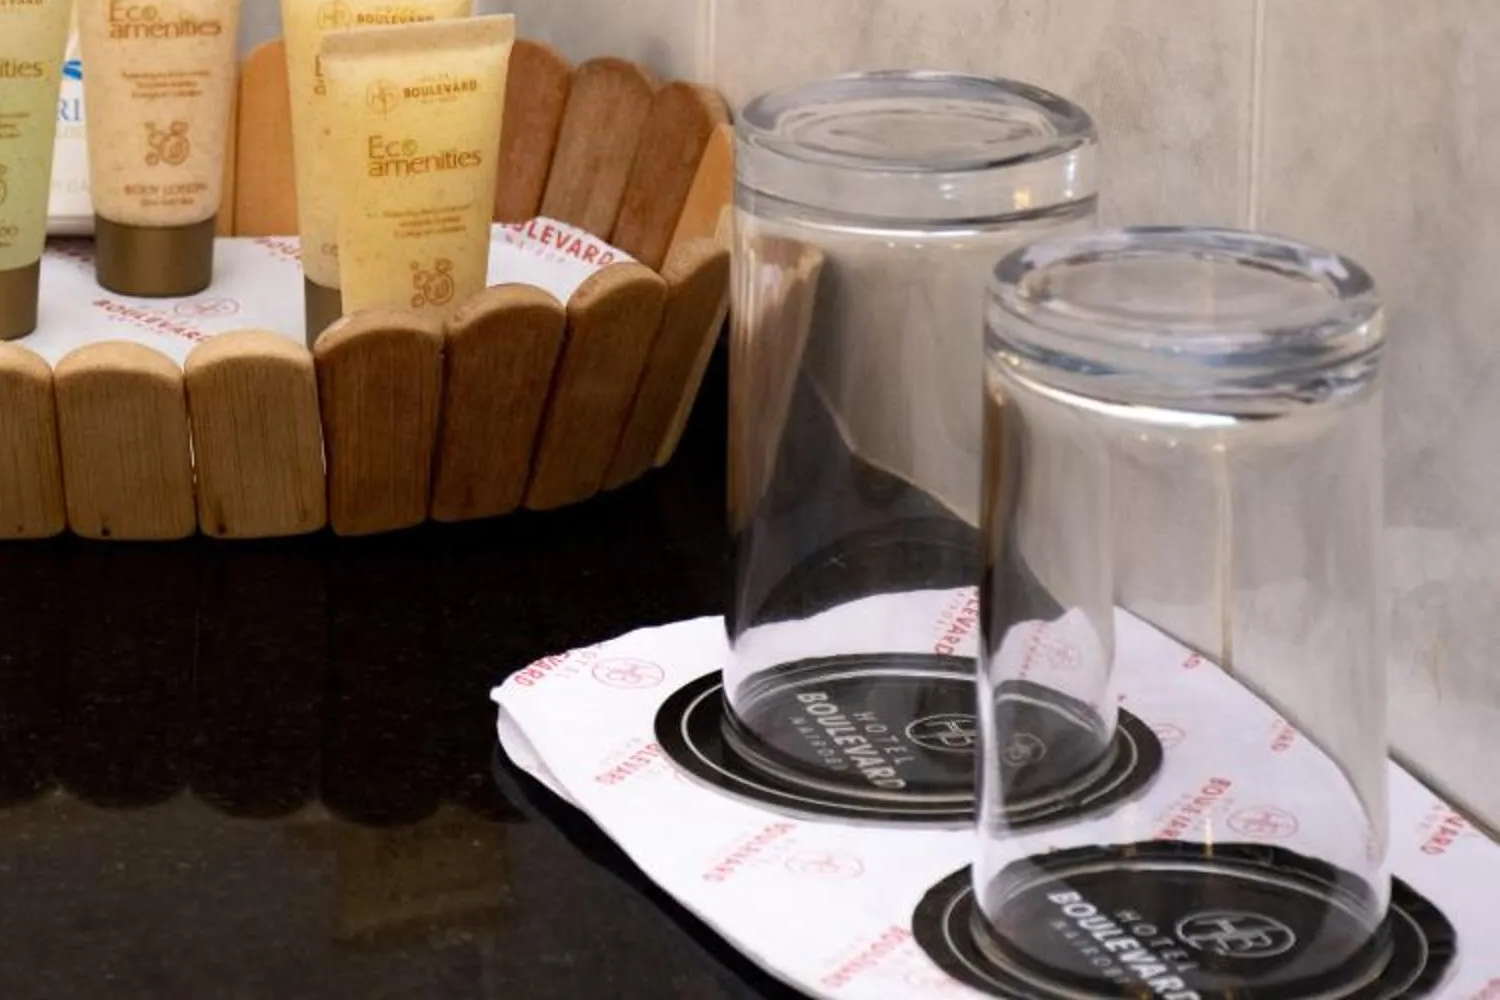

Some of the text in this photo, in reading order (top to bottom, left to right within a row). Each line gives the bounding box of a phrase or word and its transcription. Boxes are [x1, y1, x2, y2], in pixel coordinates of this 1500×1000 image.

[108, 0, 158, 22] Eco
[108, 19, 222, 39] amenities
[403, 80, 478, 99] BOULEVARD
[368, 134, 419, 159] Eco
[368, 149, 483, 177] amenities
[795, 691, 907, 789] BOULEVARD
[852, 710, 916, 765] HOTEL
[1113, 909, 1200, 974] HOTEL
